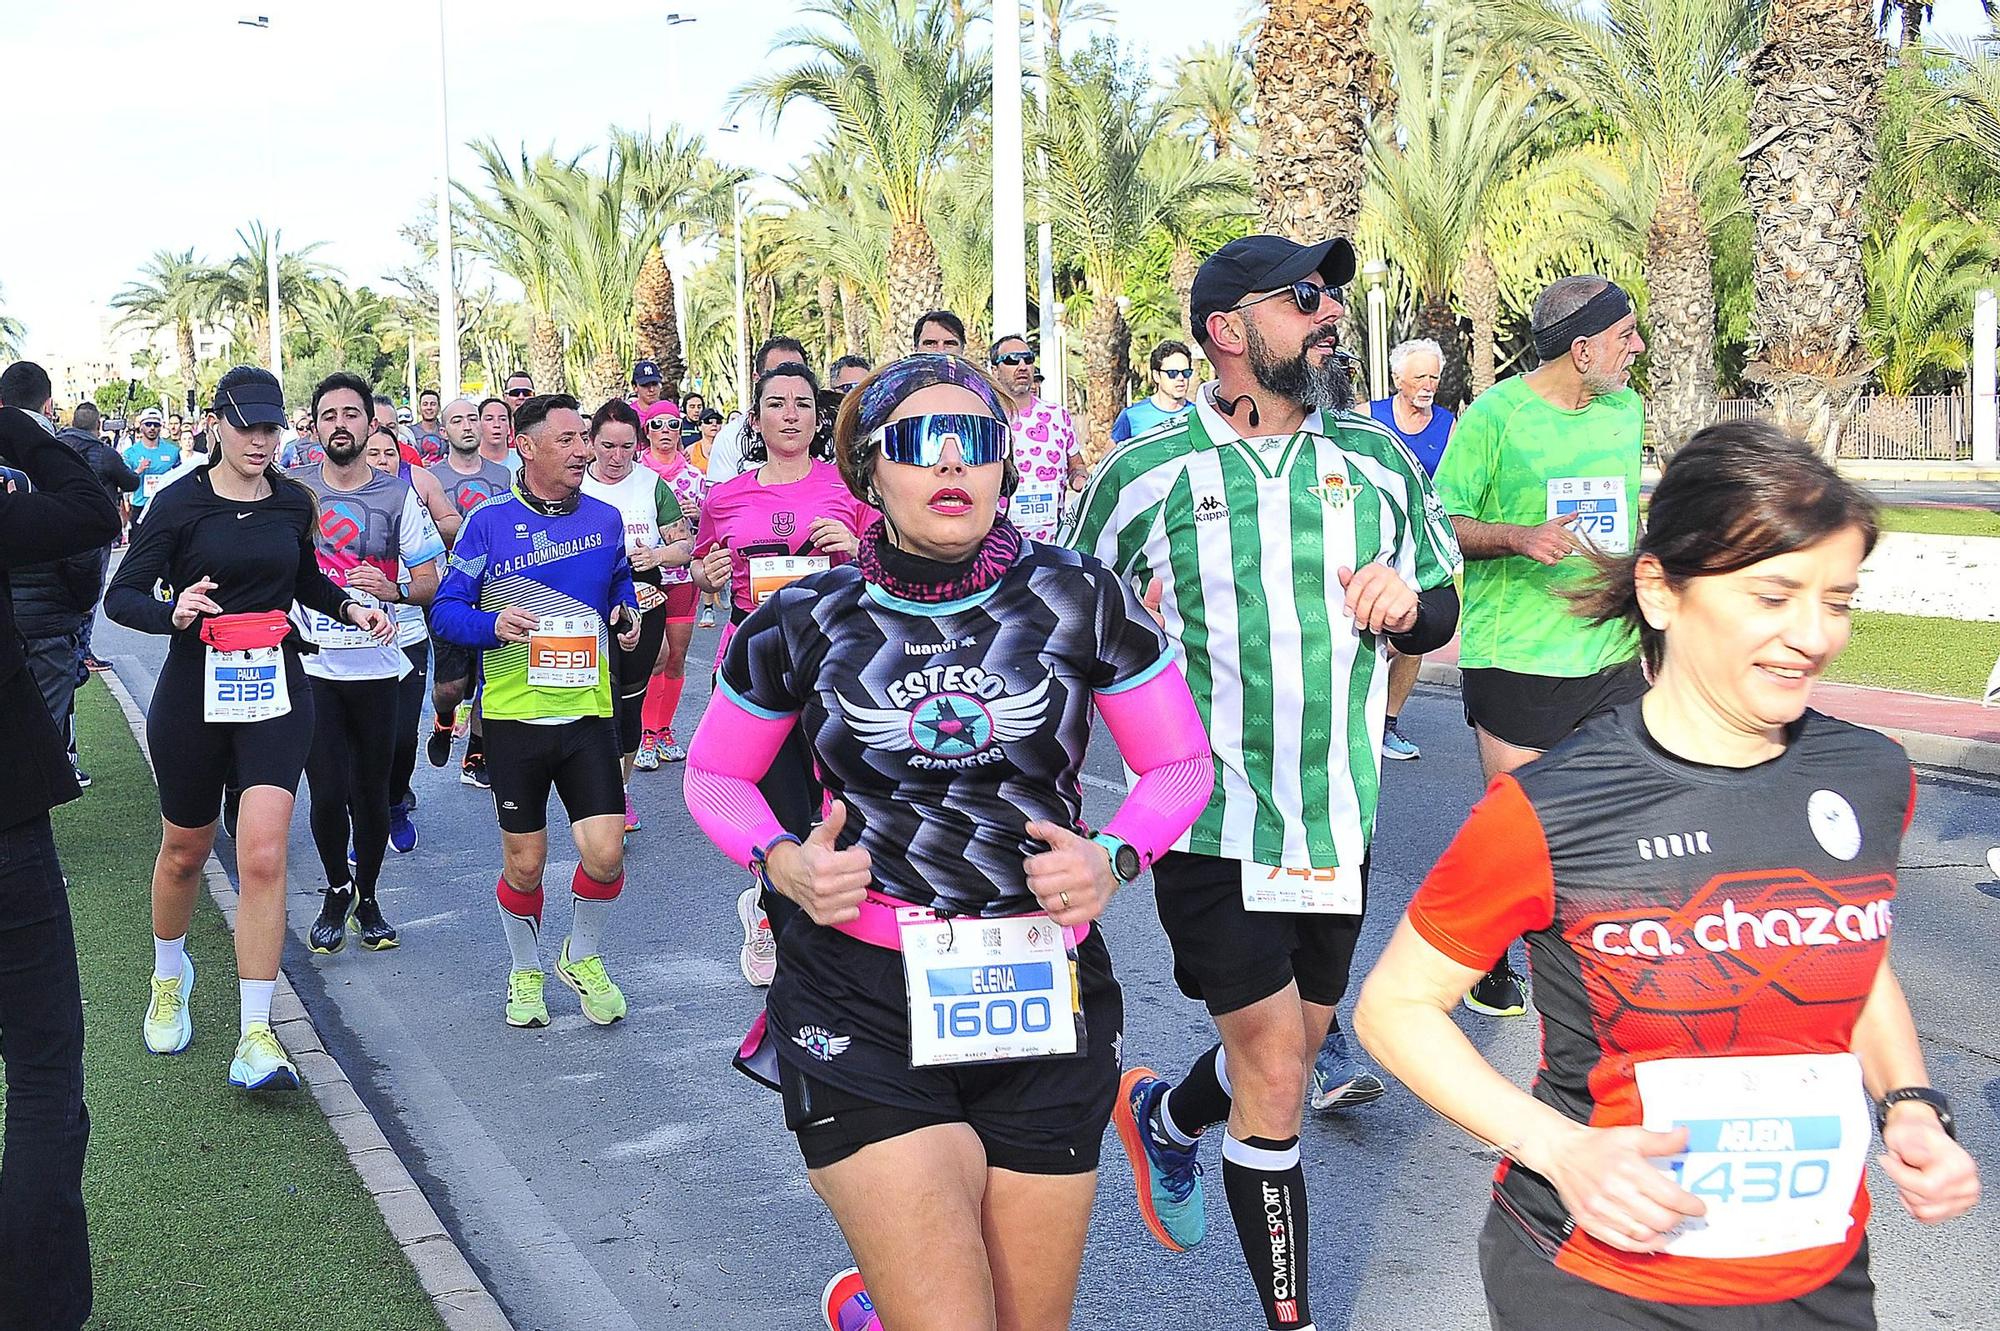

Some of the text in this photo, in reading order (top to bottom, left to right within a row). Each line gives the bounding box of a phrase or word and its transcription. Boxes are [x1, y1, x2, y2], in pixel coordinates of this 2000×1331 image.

[1020, 503, 1049, 515] 2181
[1195, 509, 1229, 523] Kappa
[905, 640, 956, 655] luanvi
[539, 650, 592, 669] 5391
[237, 669, 260, 681] PAULA
[218, 682, 274, 701] 2139
[886, 665, 1005, 708] ESTESO
[907, 748, 1004, 769] RUNNERS
[1592, 919, 1685, 957] c.a.
[971, 966, 1017, 994] ELENA
[933, 996, 1051, 1039] 1600
